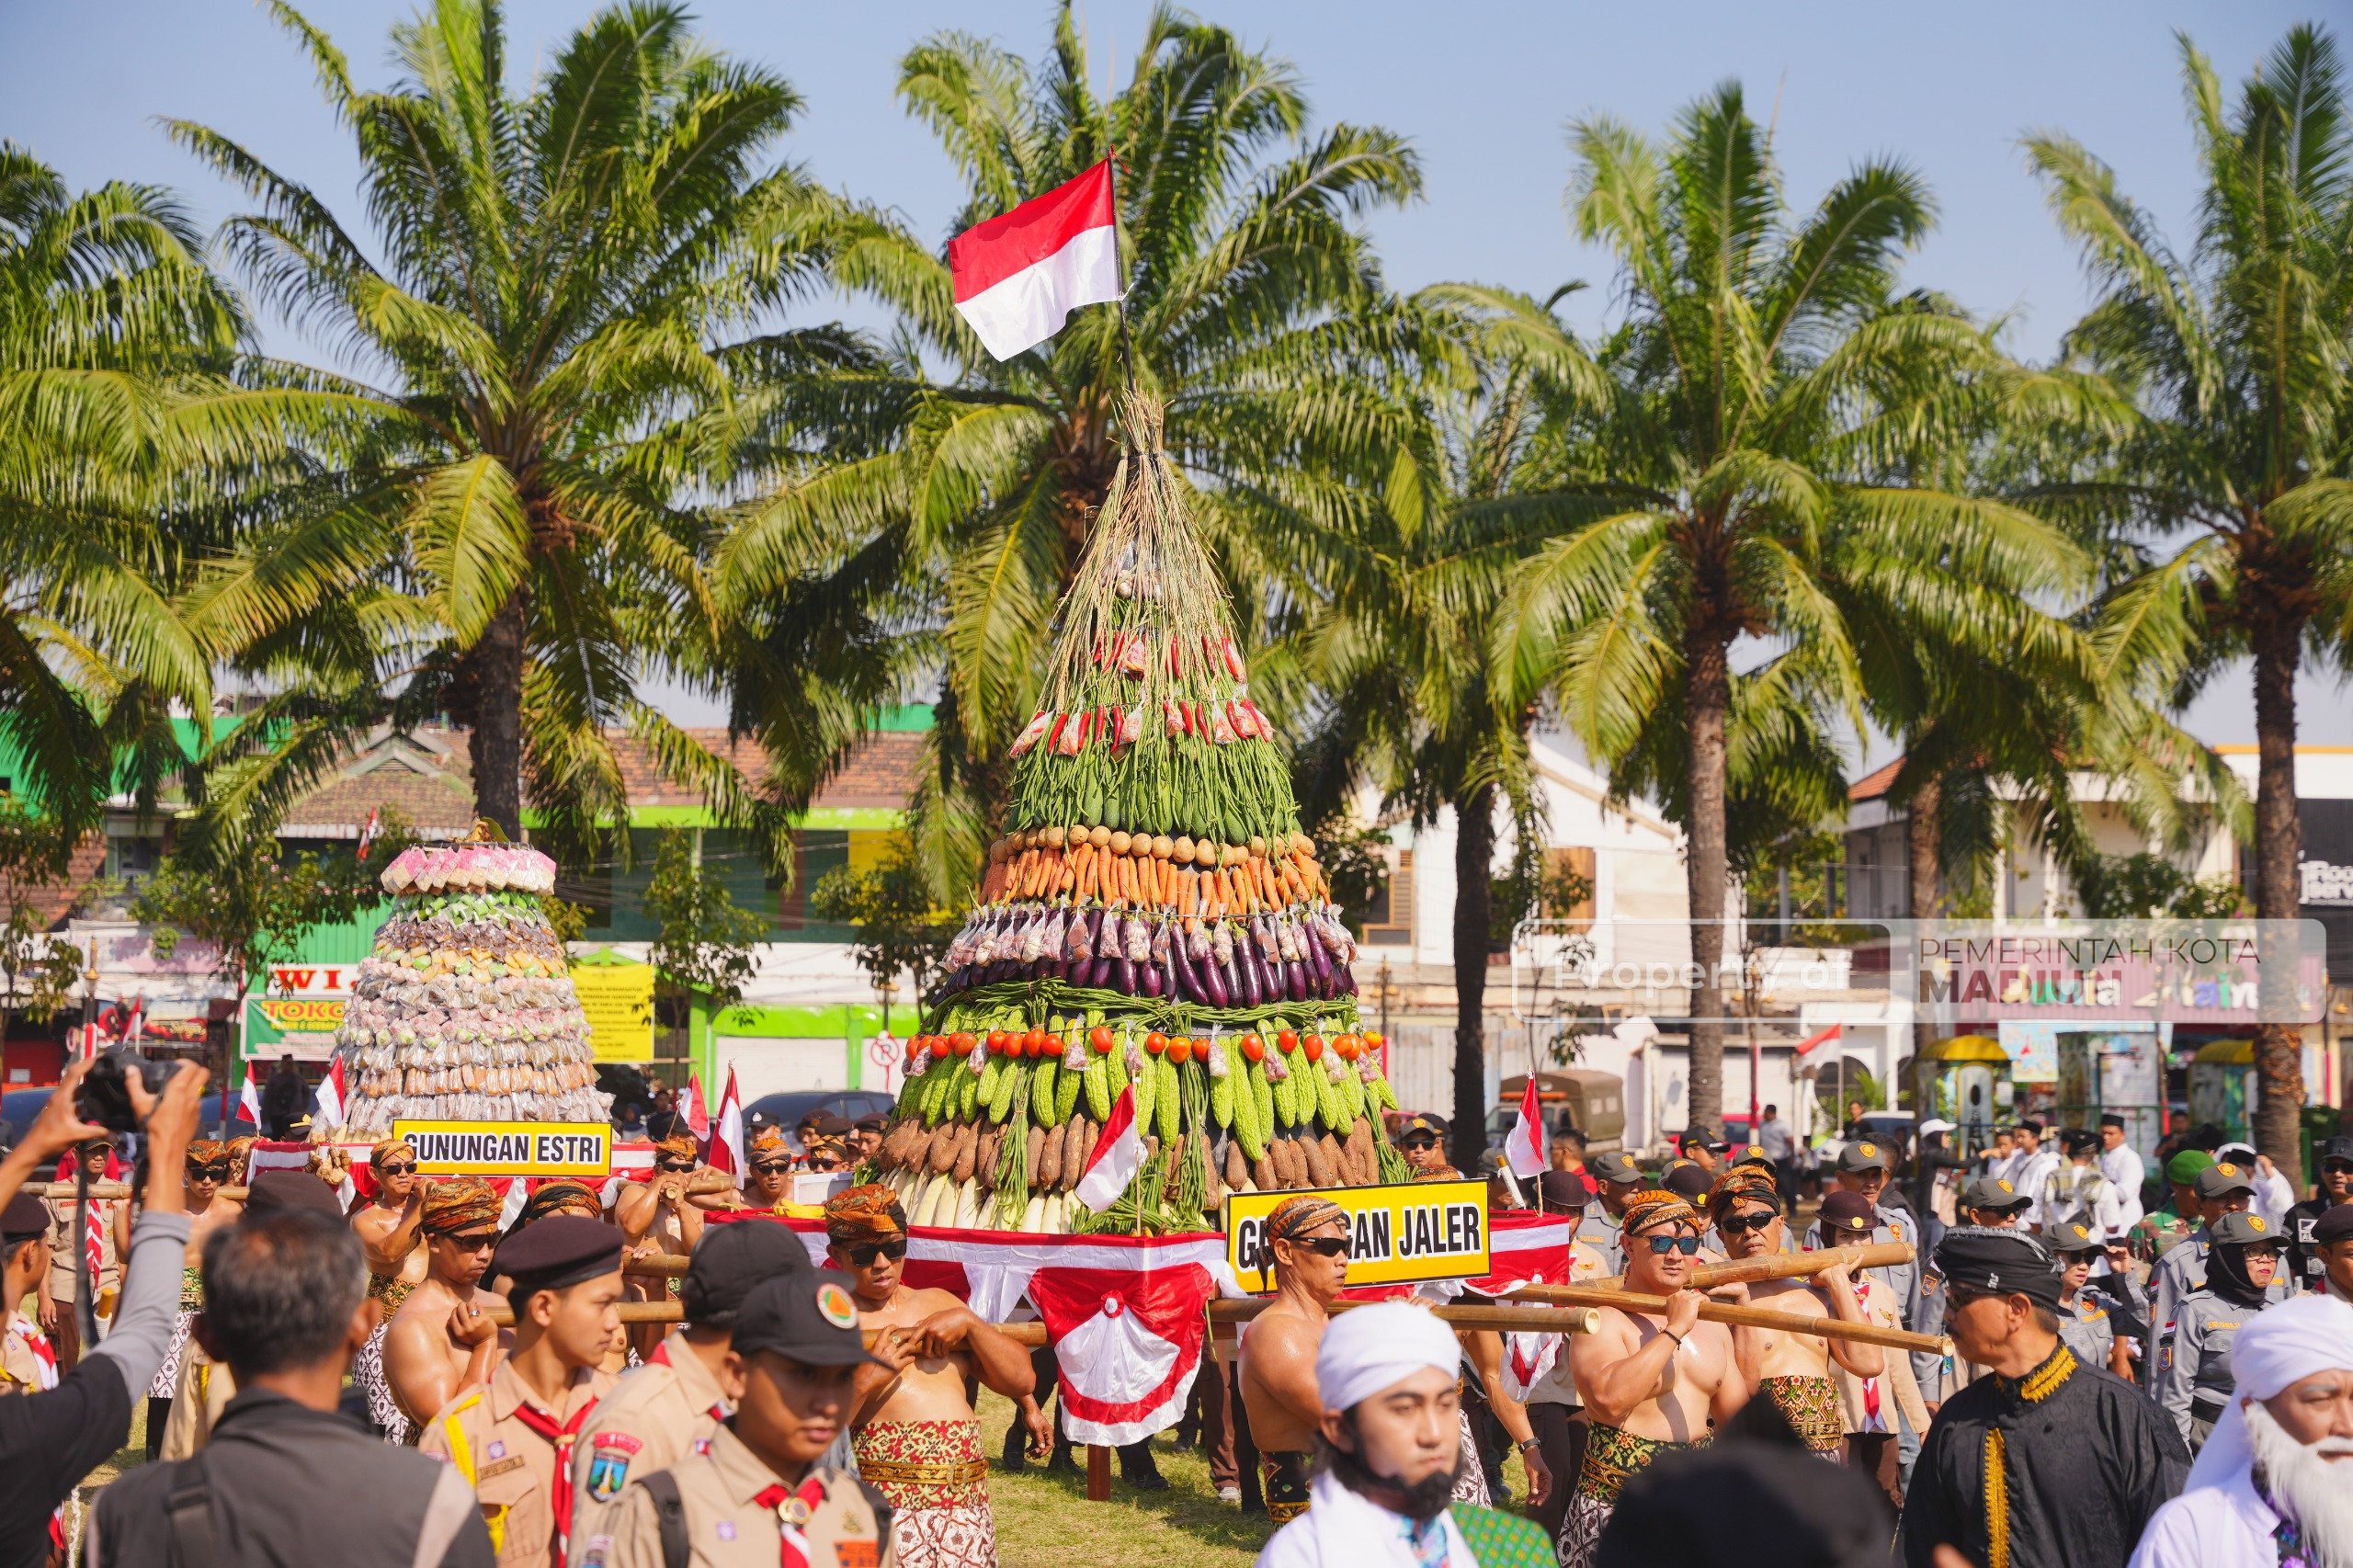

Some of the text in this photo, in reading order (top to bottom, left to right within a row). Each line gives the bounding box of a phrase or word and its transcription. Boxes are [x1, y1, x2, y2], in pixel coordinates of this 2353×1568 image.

[261, 1000, 346, 1021] TOKO
[403, 1133, 601, 1163] GUNUNGAN ESTRI
[1399, 1206, 1481, 1256] JALER
